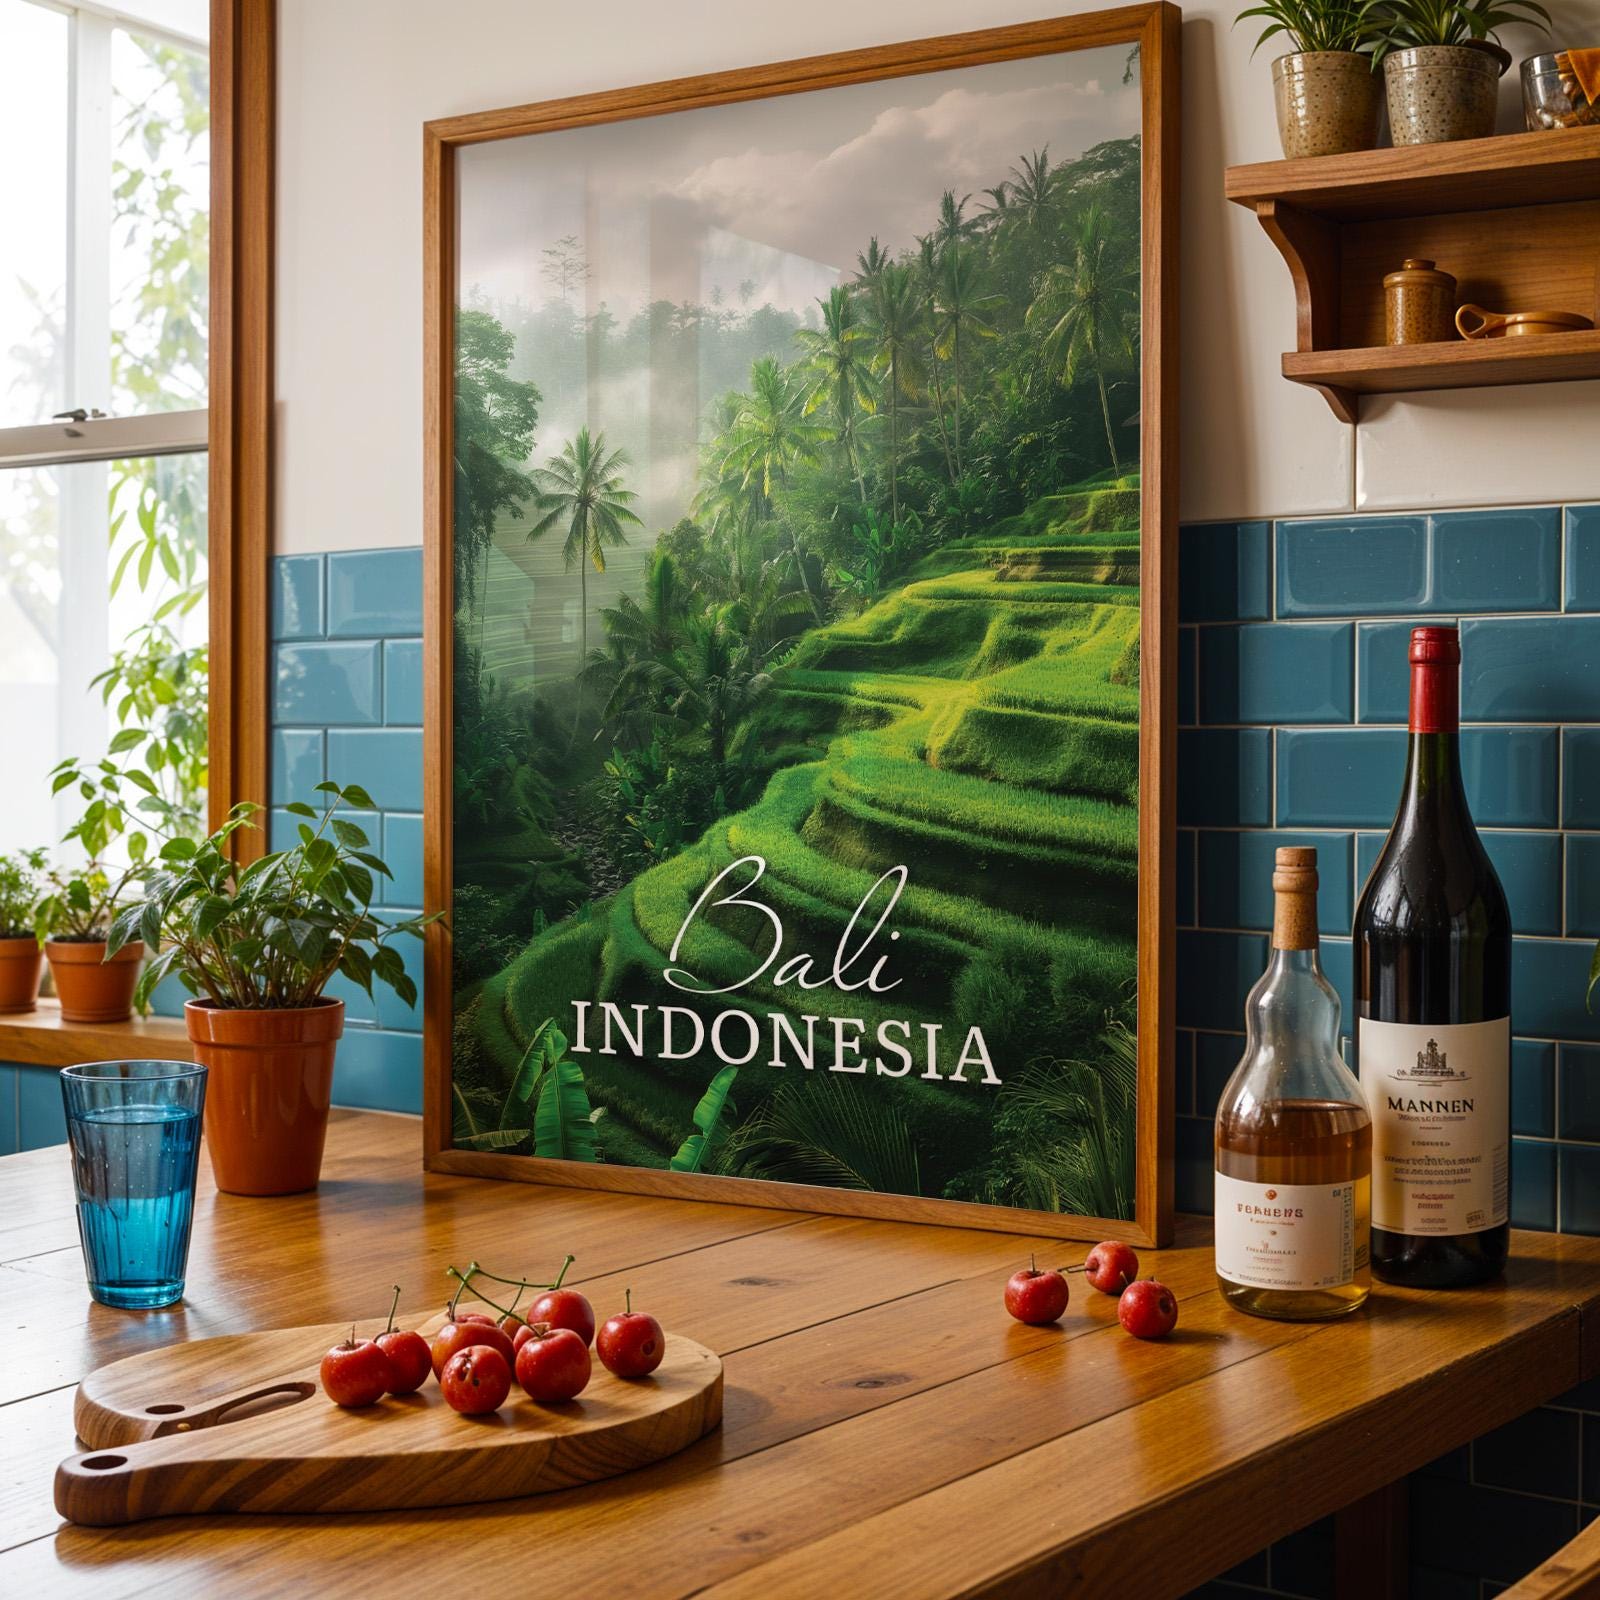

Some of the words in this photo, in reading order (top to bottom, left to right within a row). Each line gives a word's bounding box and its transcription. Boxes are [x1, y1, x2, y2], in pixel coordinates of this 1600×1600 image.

[663, 855, 908, 994] Bali
[570, 1000, 1002, 1085] INDONESIA
[1388, 1097, 1475, 1113] MANNEN
